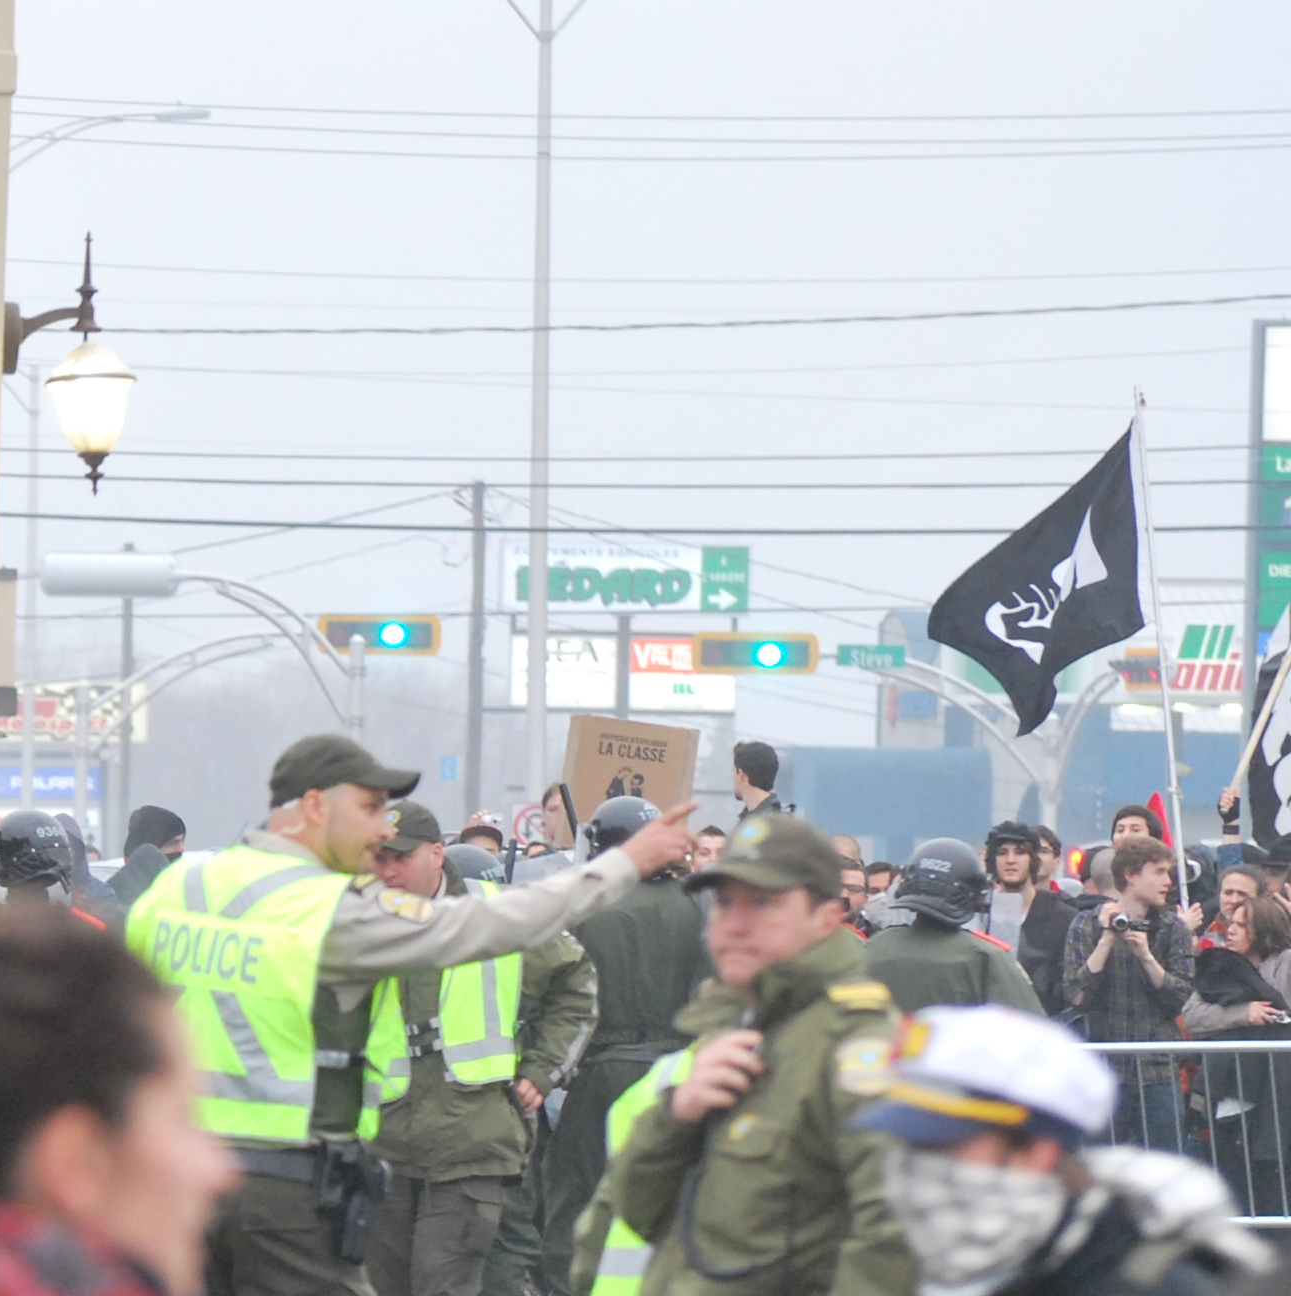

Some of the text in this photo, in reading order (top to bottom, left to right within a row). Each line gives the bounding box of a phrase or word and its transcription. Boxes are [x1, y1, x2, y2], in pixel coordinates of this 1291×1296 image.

[850, 647, 894, 668] Steve
[599, 740, 667, 764] LA CLASSE
[151, 920, 263, 985] POLICE
